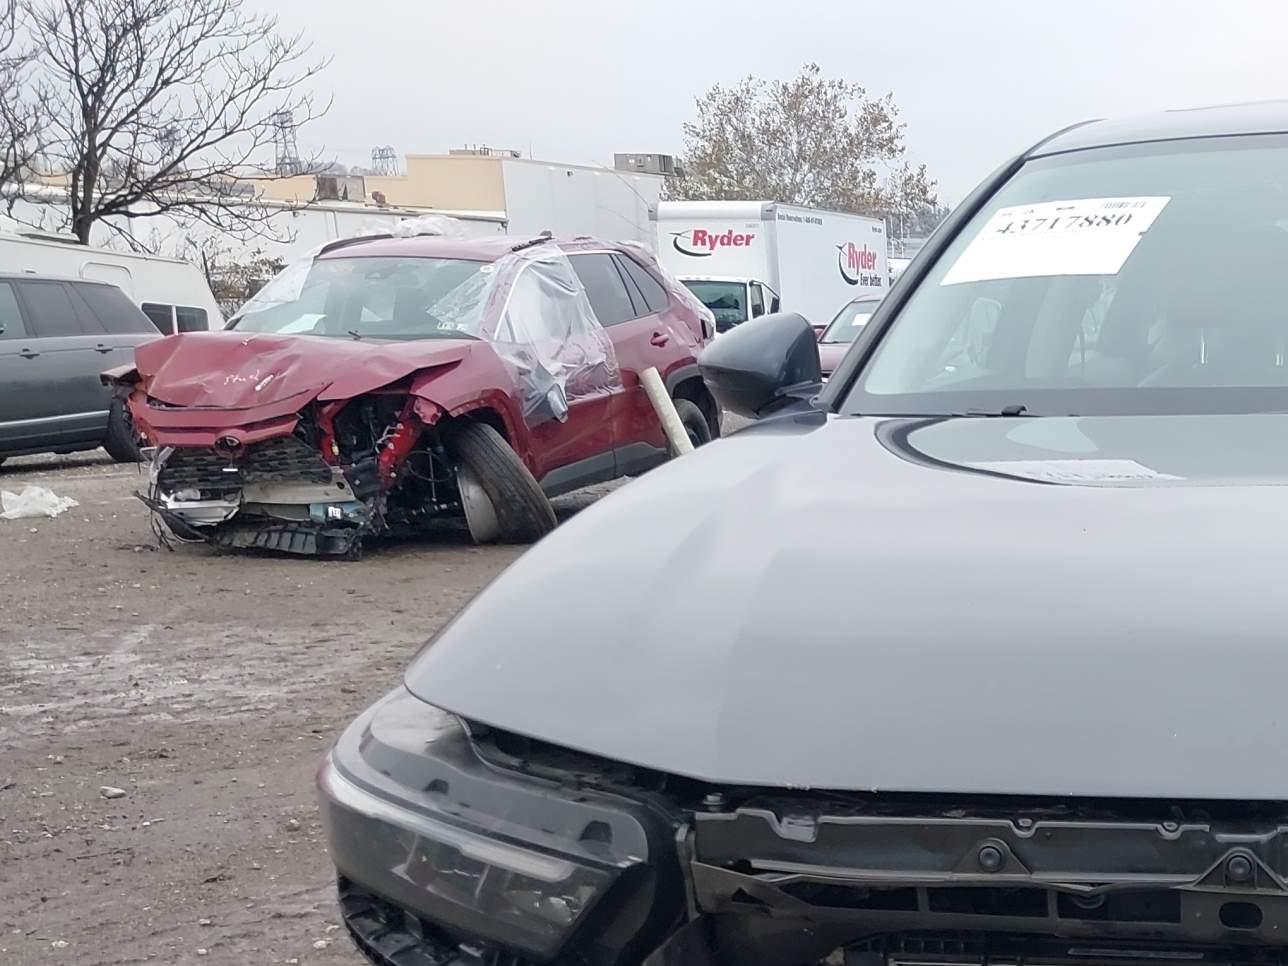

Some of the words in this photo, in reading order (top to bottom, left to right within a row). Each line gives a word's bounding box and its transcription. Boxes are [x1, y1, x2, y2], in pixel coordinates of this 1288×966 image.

[995, 212, 1134, 235] 43717880
[692, 229, 755, 251] Ryder
[847, 241, 878, 275] Ryder
